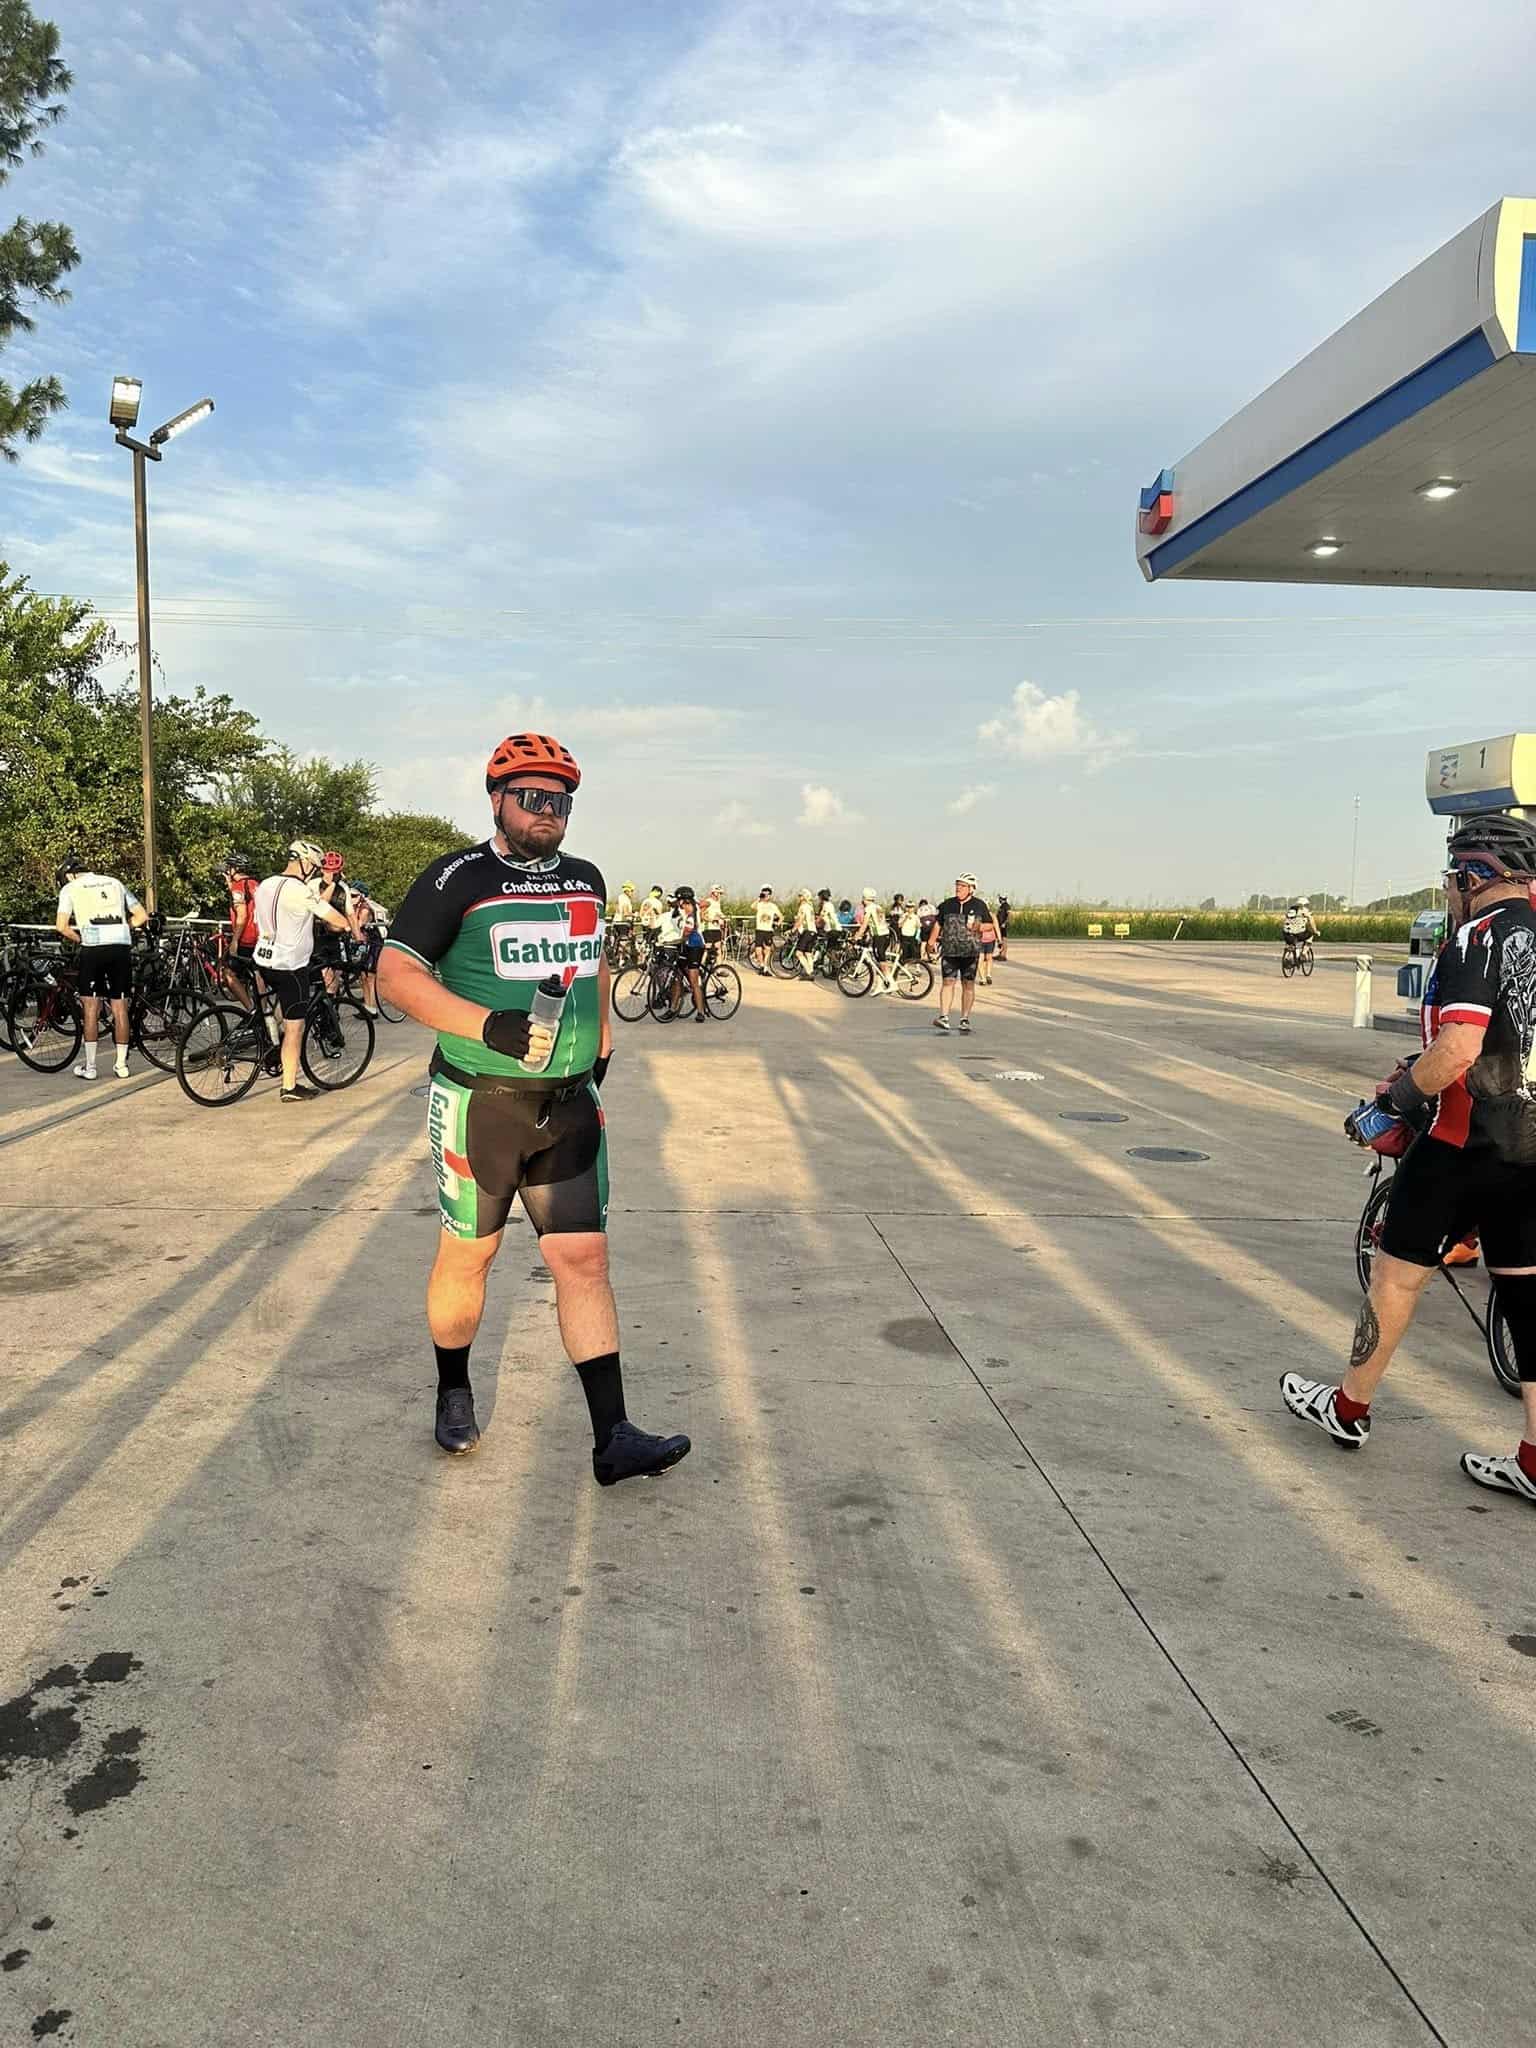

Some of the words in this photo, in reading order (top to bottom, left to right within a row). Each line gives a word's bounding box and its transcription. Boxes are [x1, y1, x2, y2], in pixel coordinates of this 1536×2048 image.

[1479, 746, 1486, 769] 1
[435, 857, 465, 890] Chateau
[501, 880, 561, 894] Chateau
[499, 934, 602, 963] Gatorad
